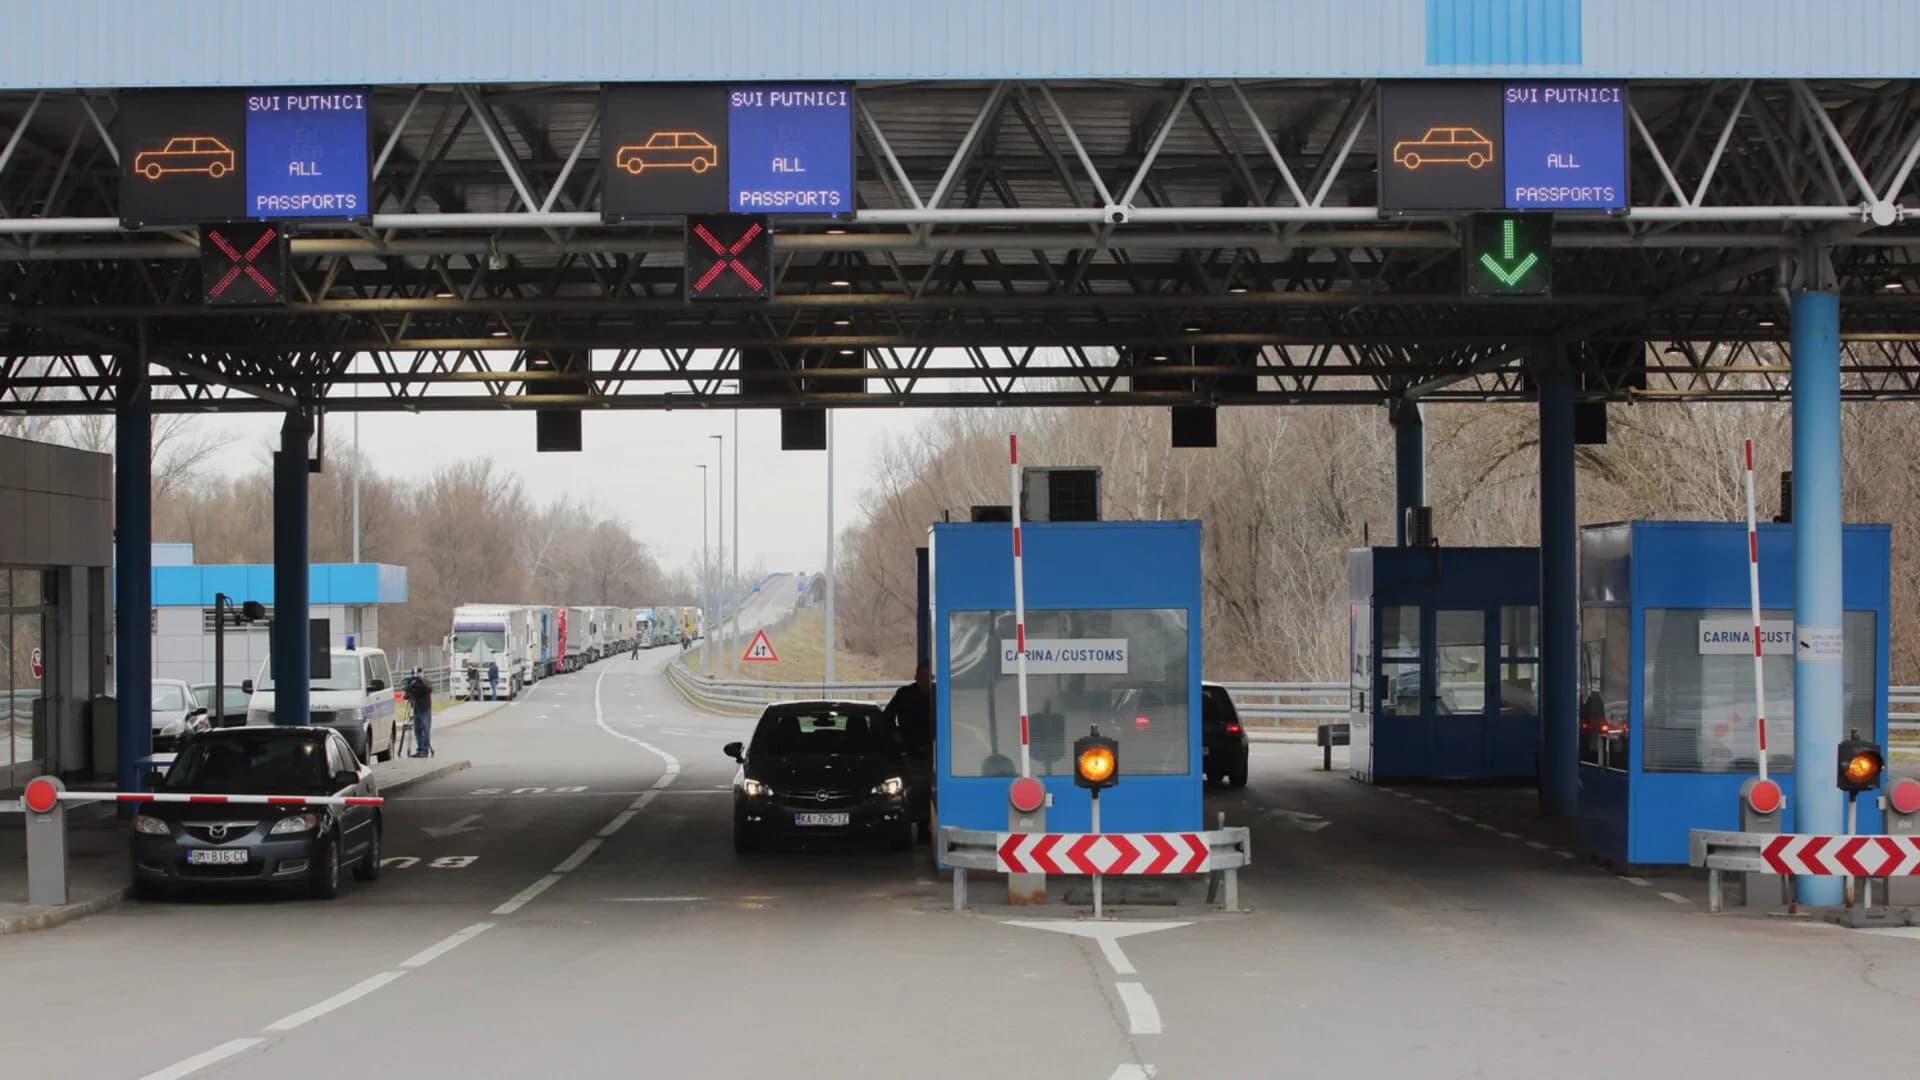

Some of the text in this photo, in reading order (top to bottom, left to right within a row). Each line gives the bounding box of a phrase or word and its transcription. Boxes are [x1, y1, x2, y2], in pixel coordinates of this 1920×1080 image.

[248, 95, 363, 111] SVI PUTNICI
[731, 91, 847, 107] SVI PUTNICI
[1506, 88, 1620, 103] SVI PUTNICI
[772, 157, 806, 173] ALL
[1547, 153, 1580, 168] ALL
[289, 161, 322, 176] ALL
[257, 194, 357, 210] PASSPORTS
[740, 190, 841, 206] PASSPORTS
[1515, 187, 1615, 202] PASSPORTS
[1703, 631, 1795, 644] CARINACUST
